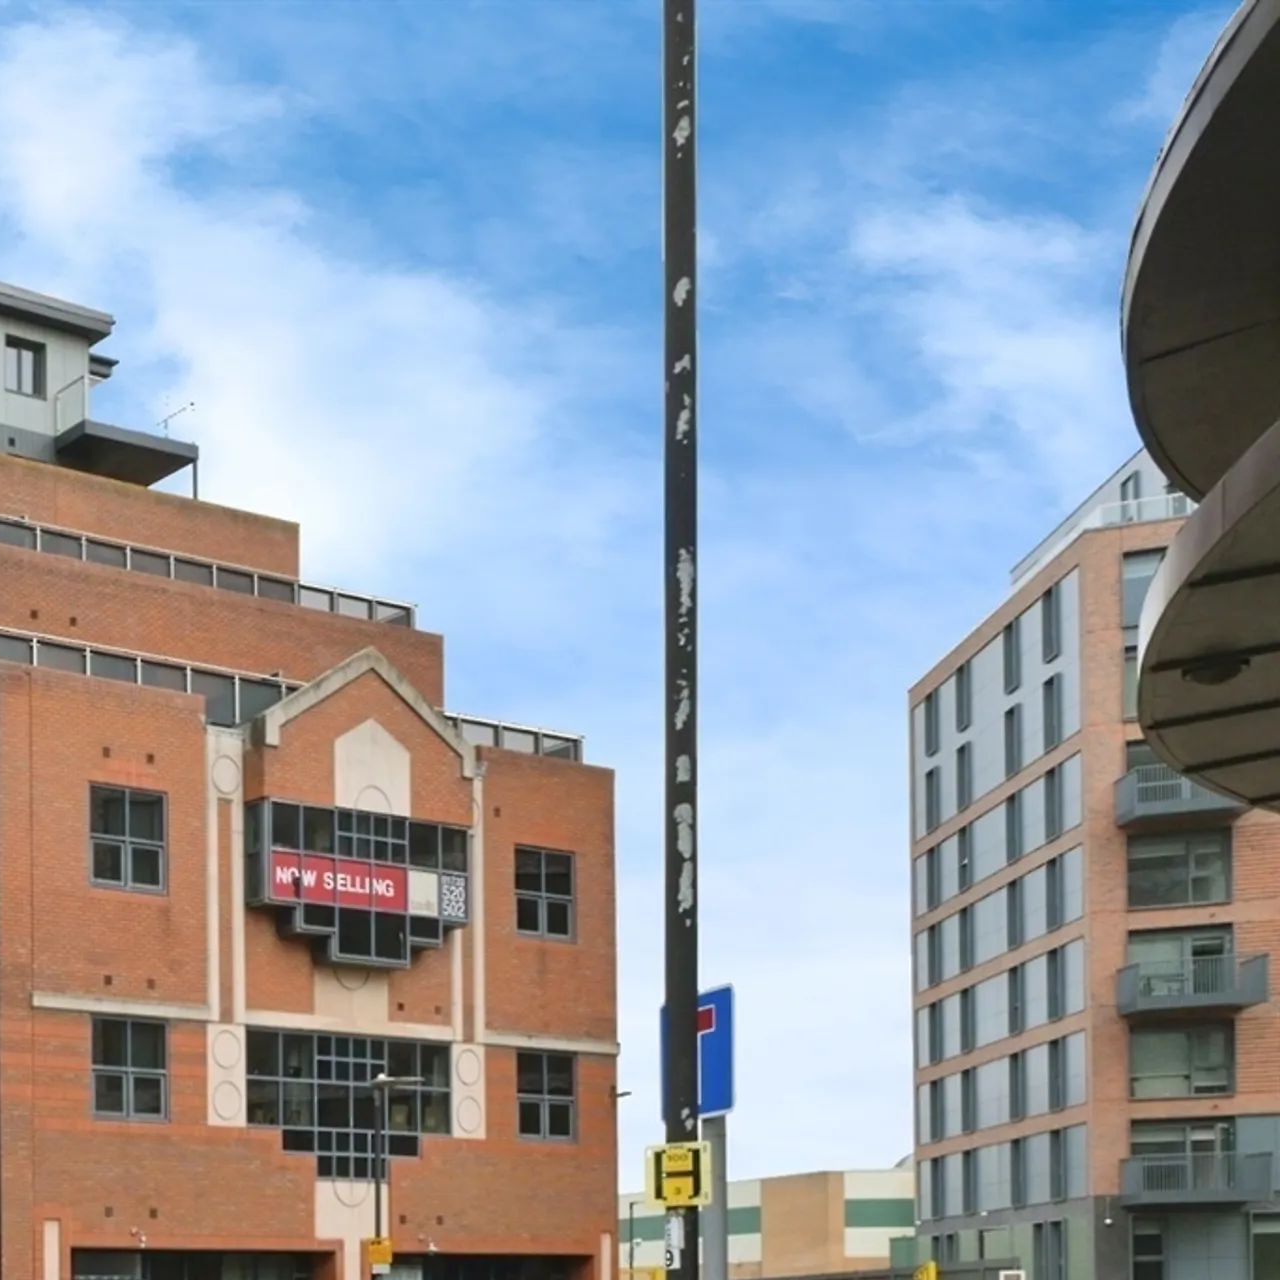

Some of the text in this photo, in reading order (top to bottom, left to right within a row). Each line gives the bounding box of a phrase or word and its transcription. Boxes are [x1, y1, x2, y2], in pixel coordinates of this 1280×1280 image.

[275, 866, 395, 898] NOW SELLING
[442, 885, 465, 902] 520
[442, 900, 466, 918] 502
